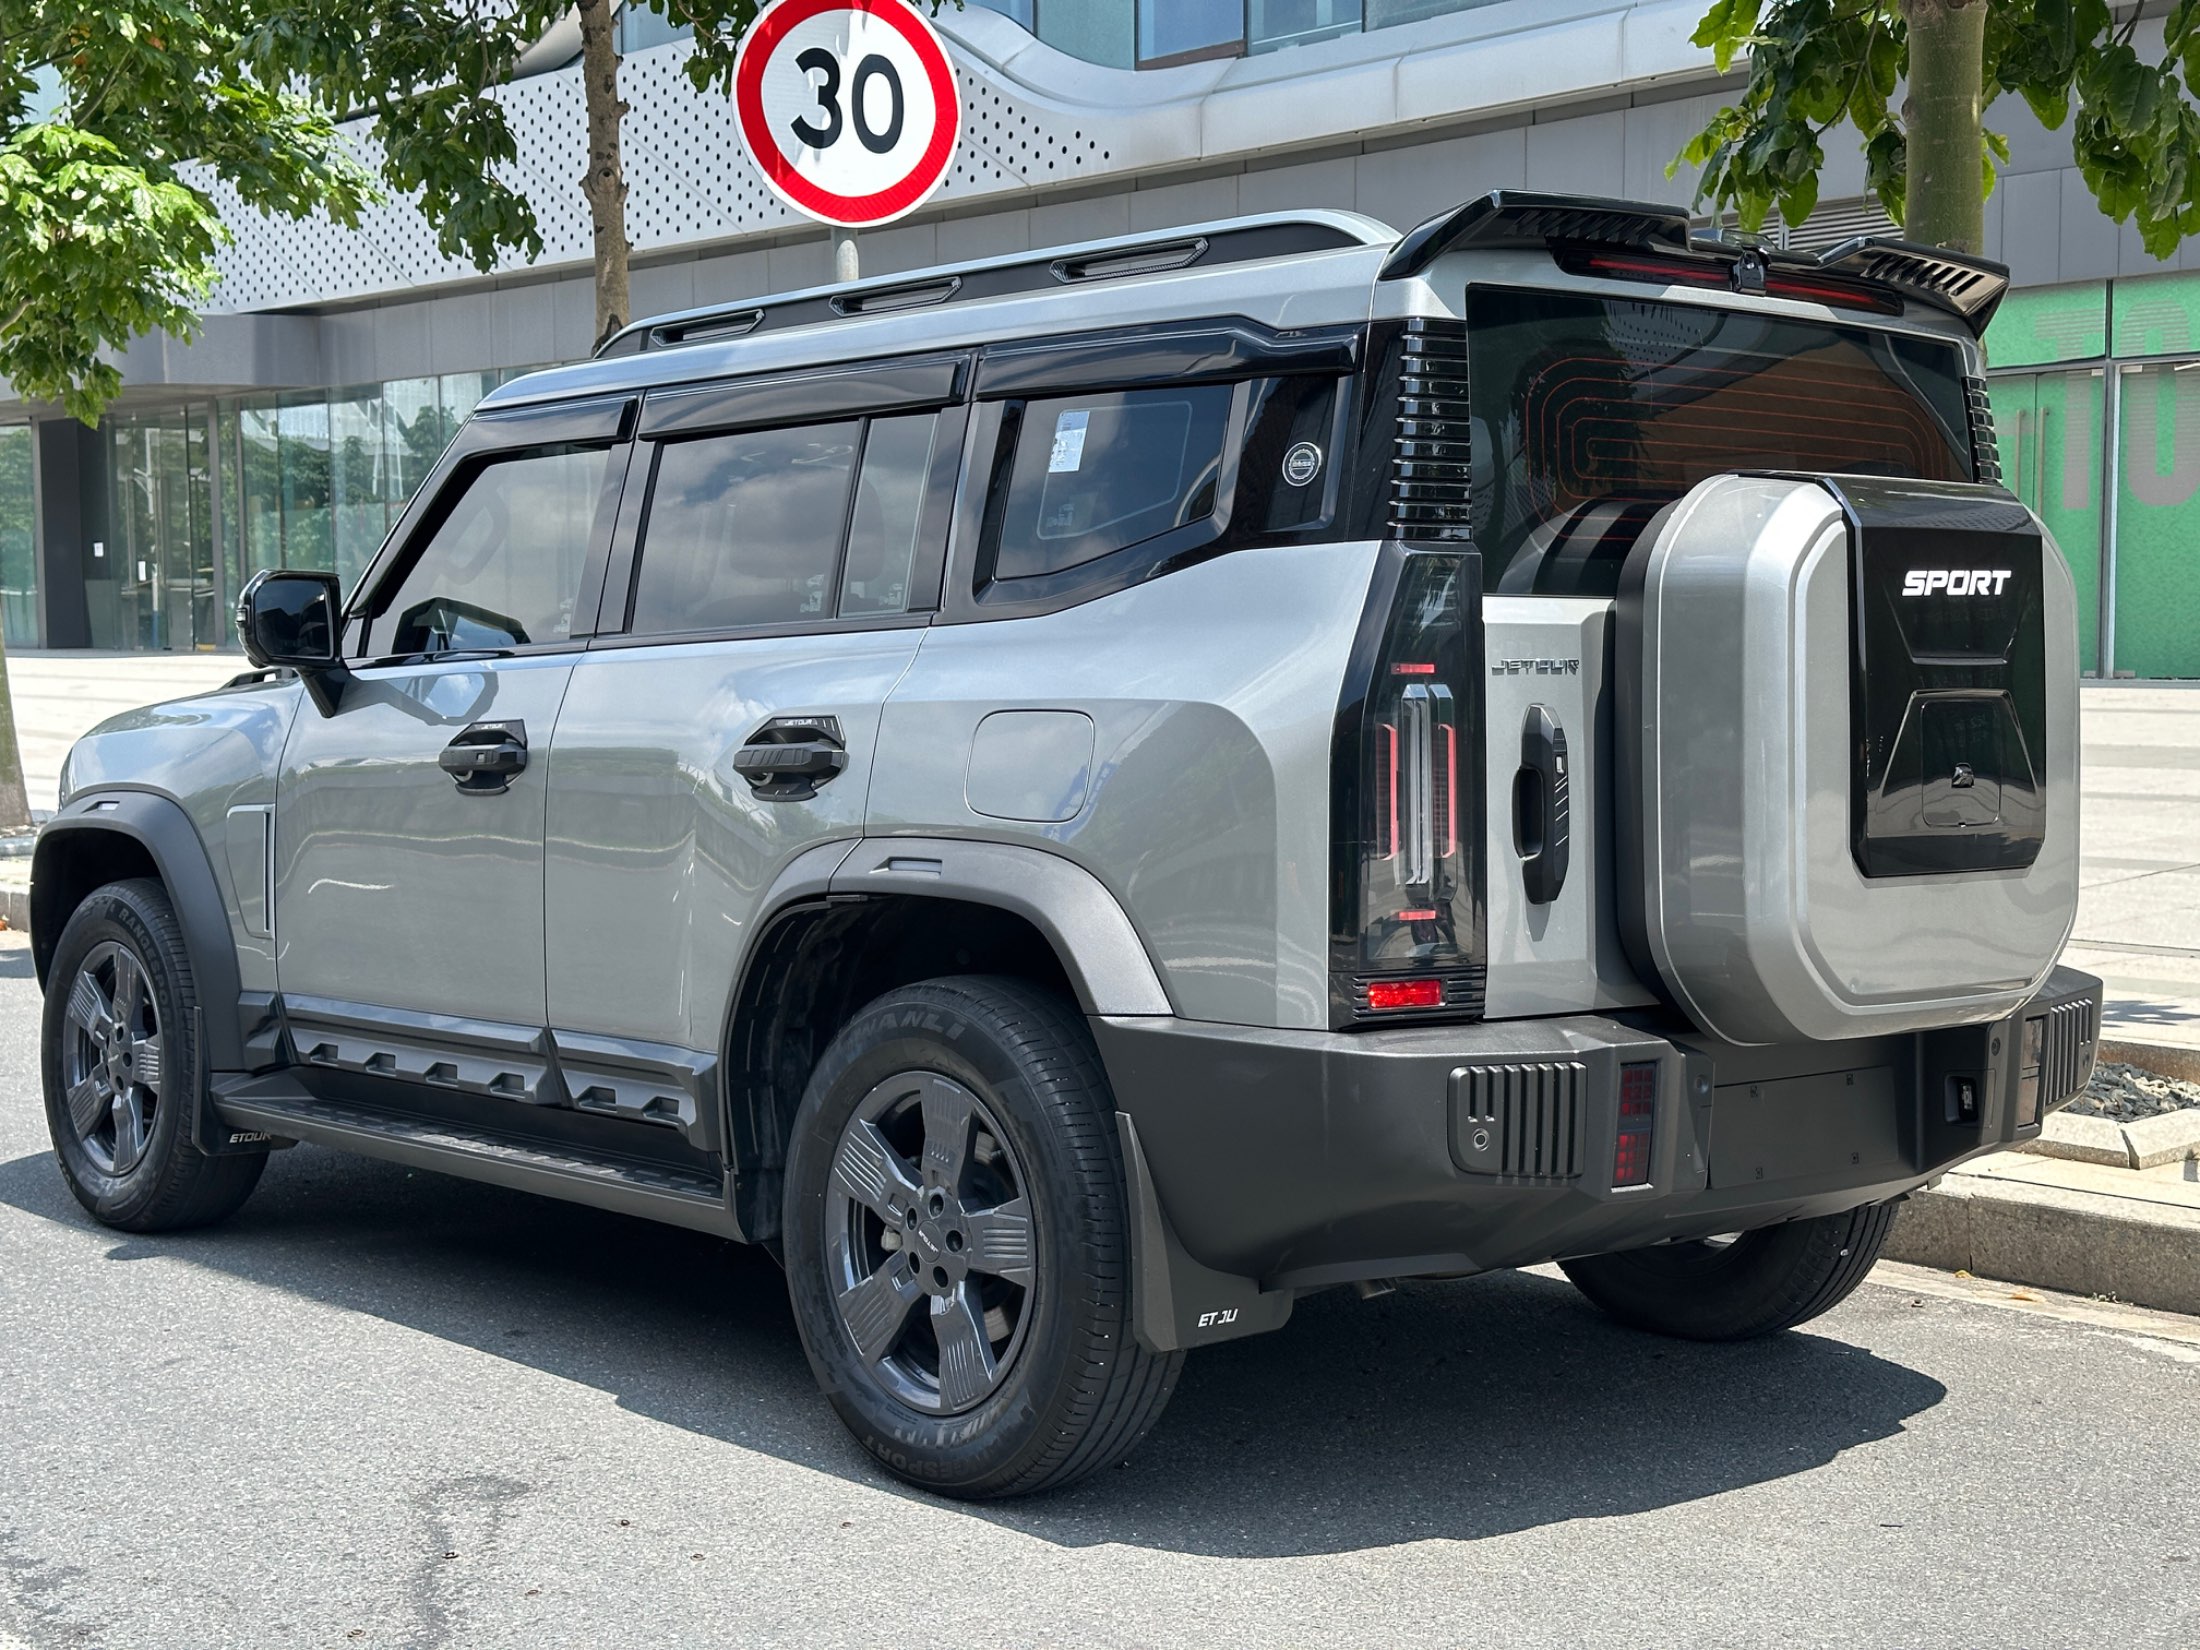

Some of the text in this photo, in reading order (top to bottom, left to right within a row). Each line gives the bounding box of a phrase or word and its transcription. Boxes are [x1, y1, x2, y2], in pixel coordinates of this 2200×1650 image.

[790, 47, 904, 154] 30
[1902, 570, 2012, 596] SPORT
[1491, 658, 1579, 675] JETOUR
[859, 1010, 967, 1040] WANLI
